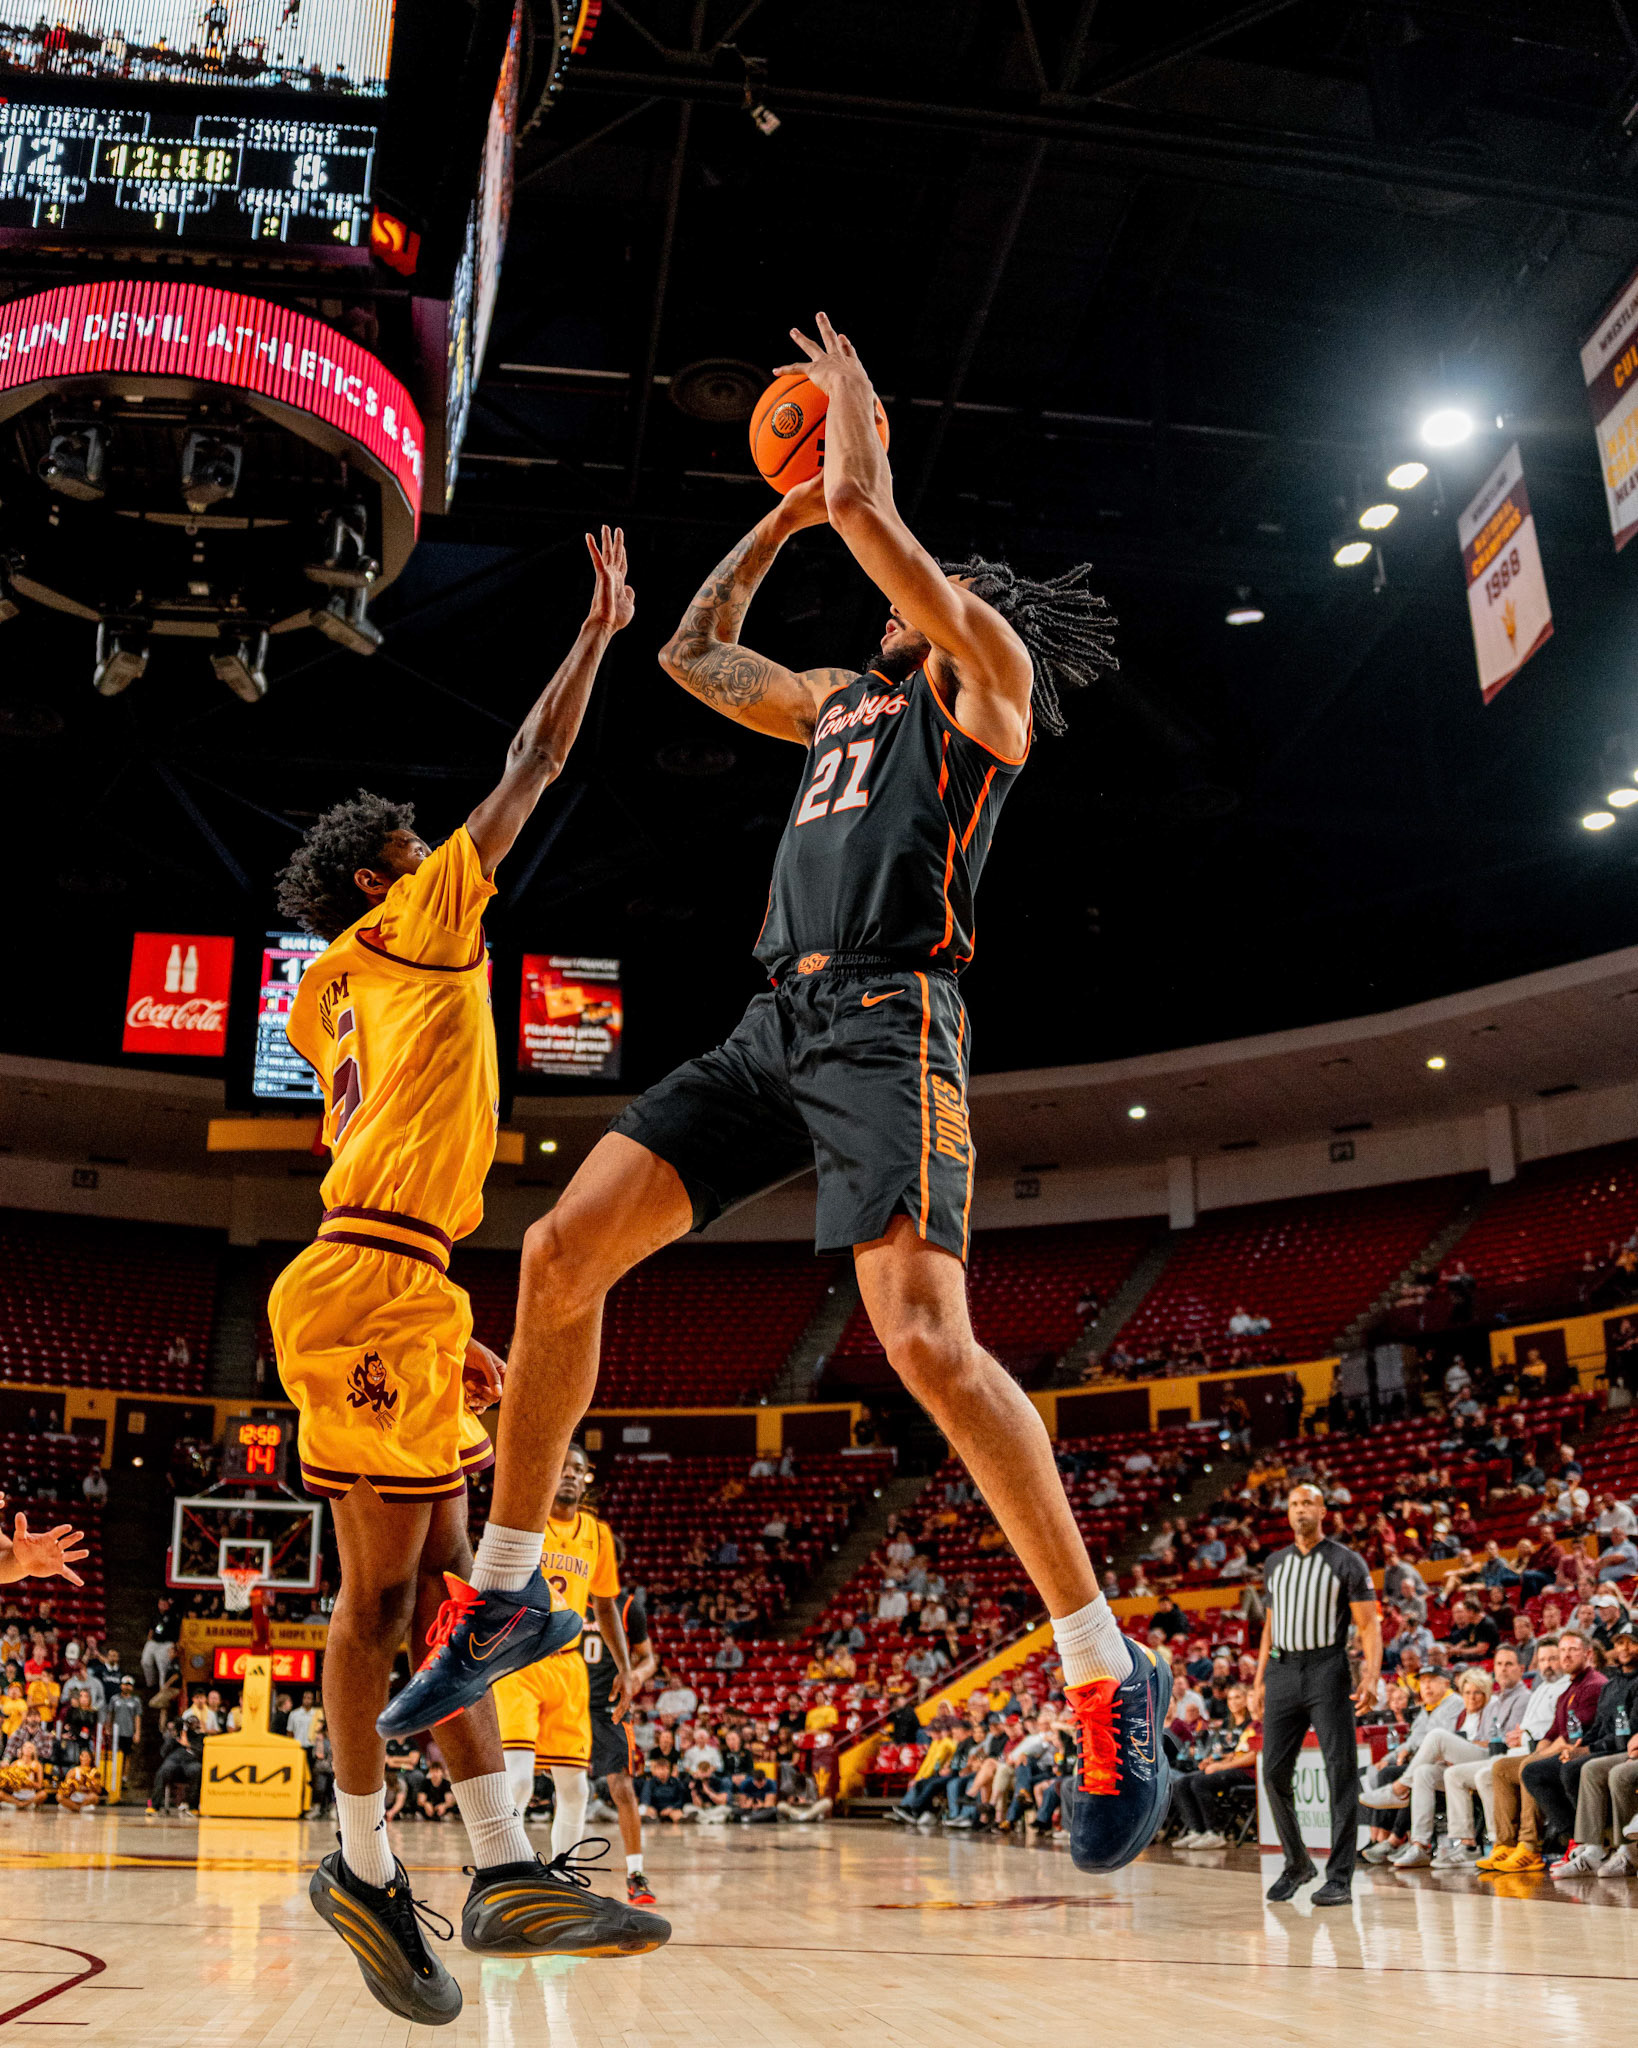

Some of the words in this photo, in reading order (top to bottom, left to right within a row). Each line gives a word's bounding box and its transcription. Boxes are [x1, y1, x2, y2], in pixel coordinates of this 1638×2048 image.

[104, 143, 232, 183] 12:58
[0, 317, 70, 362] SUN
[83, 311, 190, 345] DEVIL
[206, 323, 378, 417] ATHLETICS
[1485, 548, 1521, 607] 1988
[795, 738, 875, 827] 21
[126, 995, 229, 1032] Coca-Cola
[931, 1073, 968, 1165] POKES
[239, 1423, 282, 1446] 12:58
[246, 1445, 276, 1475] 14
[583, 1634, 603, 1665] 0
